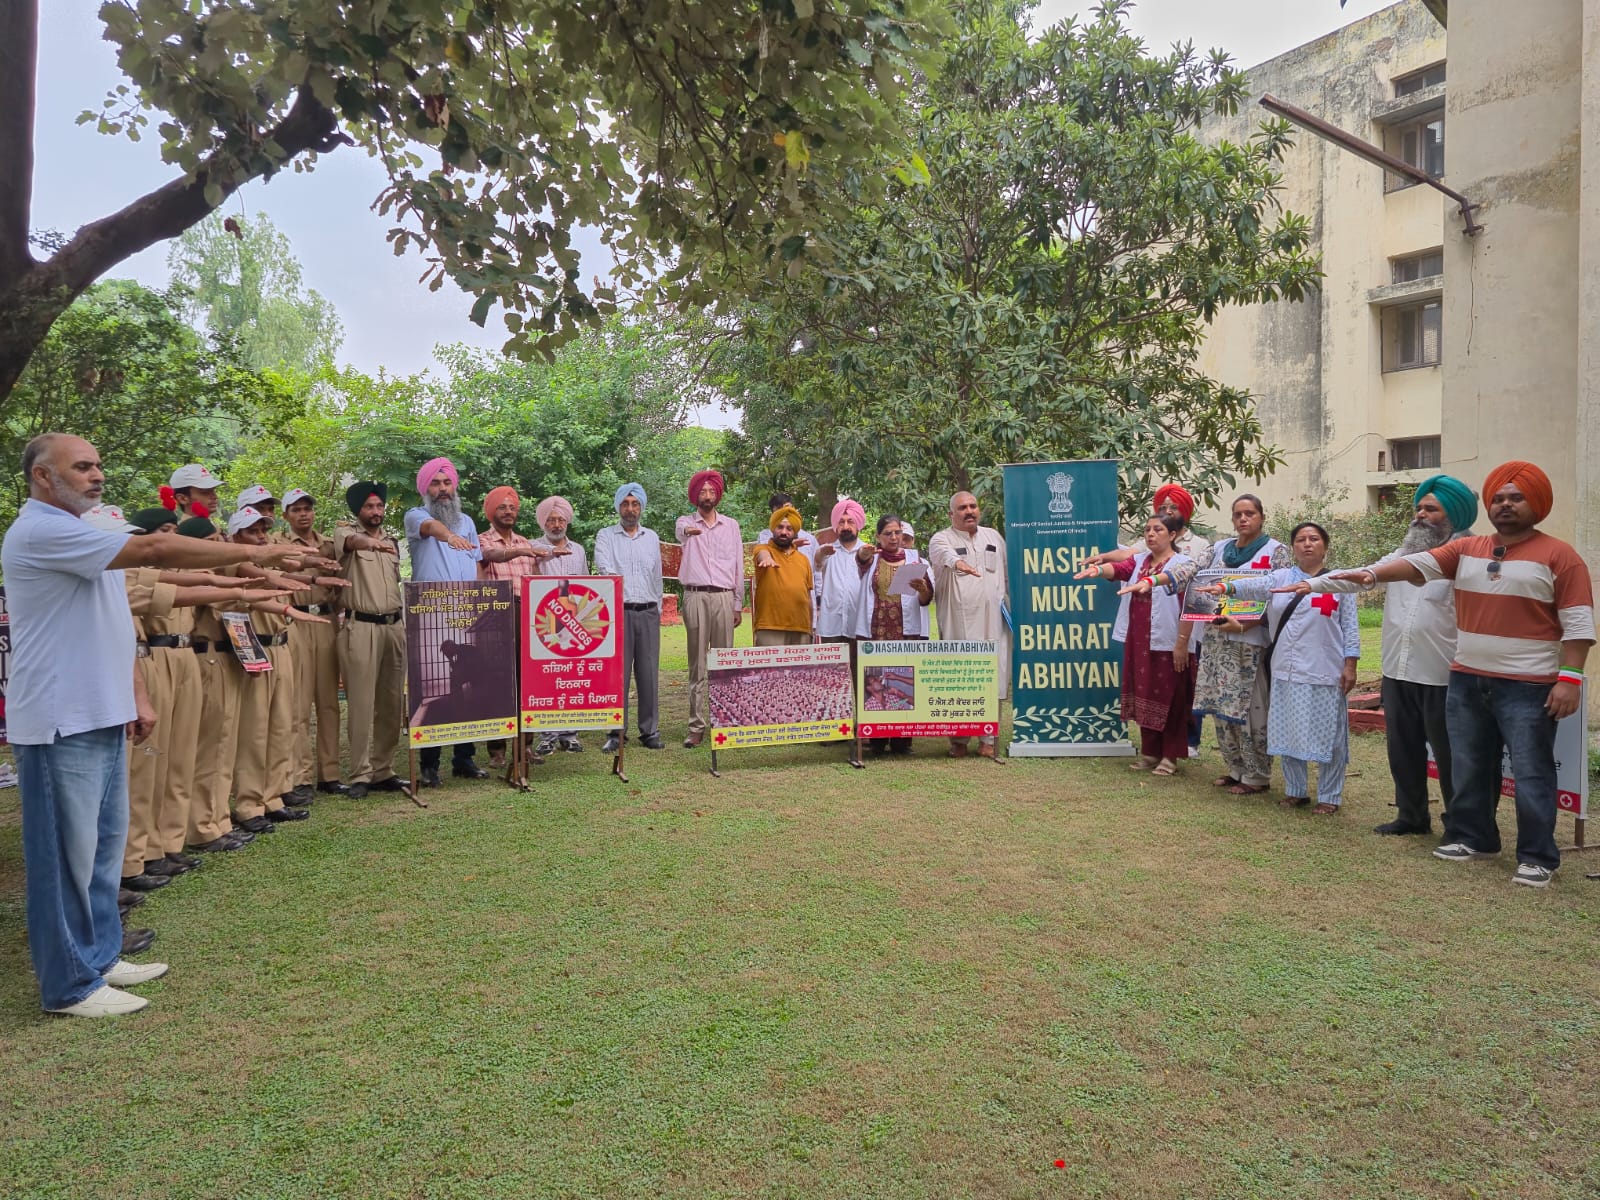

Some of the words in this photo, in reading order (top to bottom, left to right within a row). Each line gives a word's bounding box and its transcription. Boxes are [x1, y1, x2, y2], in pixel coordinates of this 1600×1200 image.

[1031, 584, 1097, 612] MUKT
[548, 598, 564, 614] NO
[561, 613, 592, 646] DRUGS
[875, 642, 904, 653] NASHA
[904, 642, 926, 653] MUKT
[928, 642, 960, 653] BHARAT
[961, 642, 995, 652] ABHIYAN
[1020, 623, 1112, 651] BHARAT
[588, 660, 603, 671] ਕਰੋ
[1018, 662, 1120, 689] ABHIYAN
[555, 678, 591, 689] ਇਨਕਾਰ
[558, 693, 566, 709] ਨੂੰ
[569, 692, 584, 704] ਕਰੋ
[588, 692, 618, 704] ਪਿਆਰ
